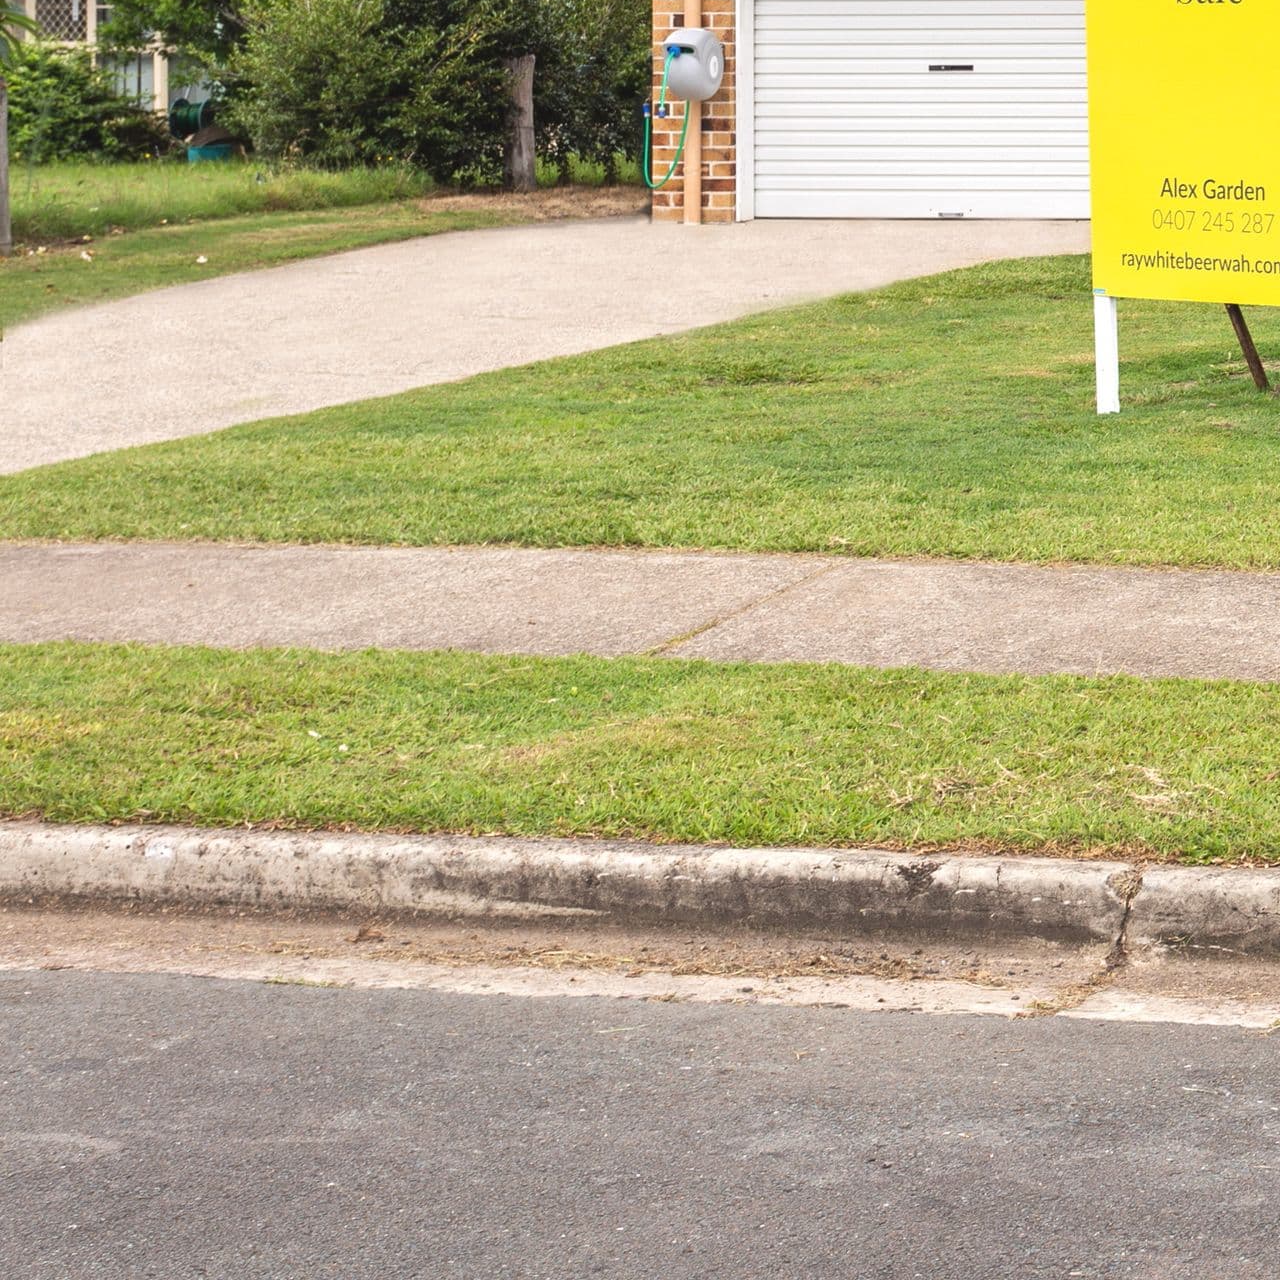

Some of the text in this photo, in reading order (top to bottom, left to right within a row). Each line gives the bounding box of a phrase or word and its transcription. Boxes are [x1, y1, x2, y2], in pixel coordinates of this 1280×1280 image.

[1159, 177, 1266, 202] Alex Garden
[1152, 208, 1275, 234] 0407 245 287
